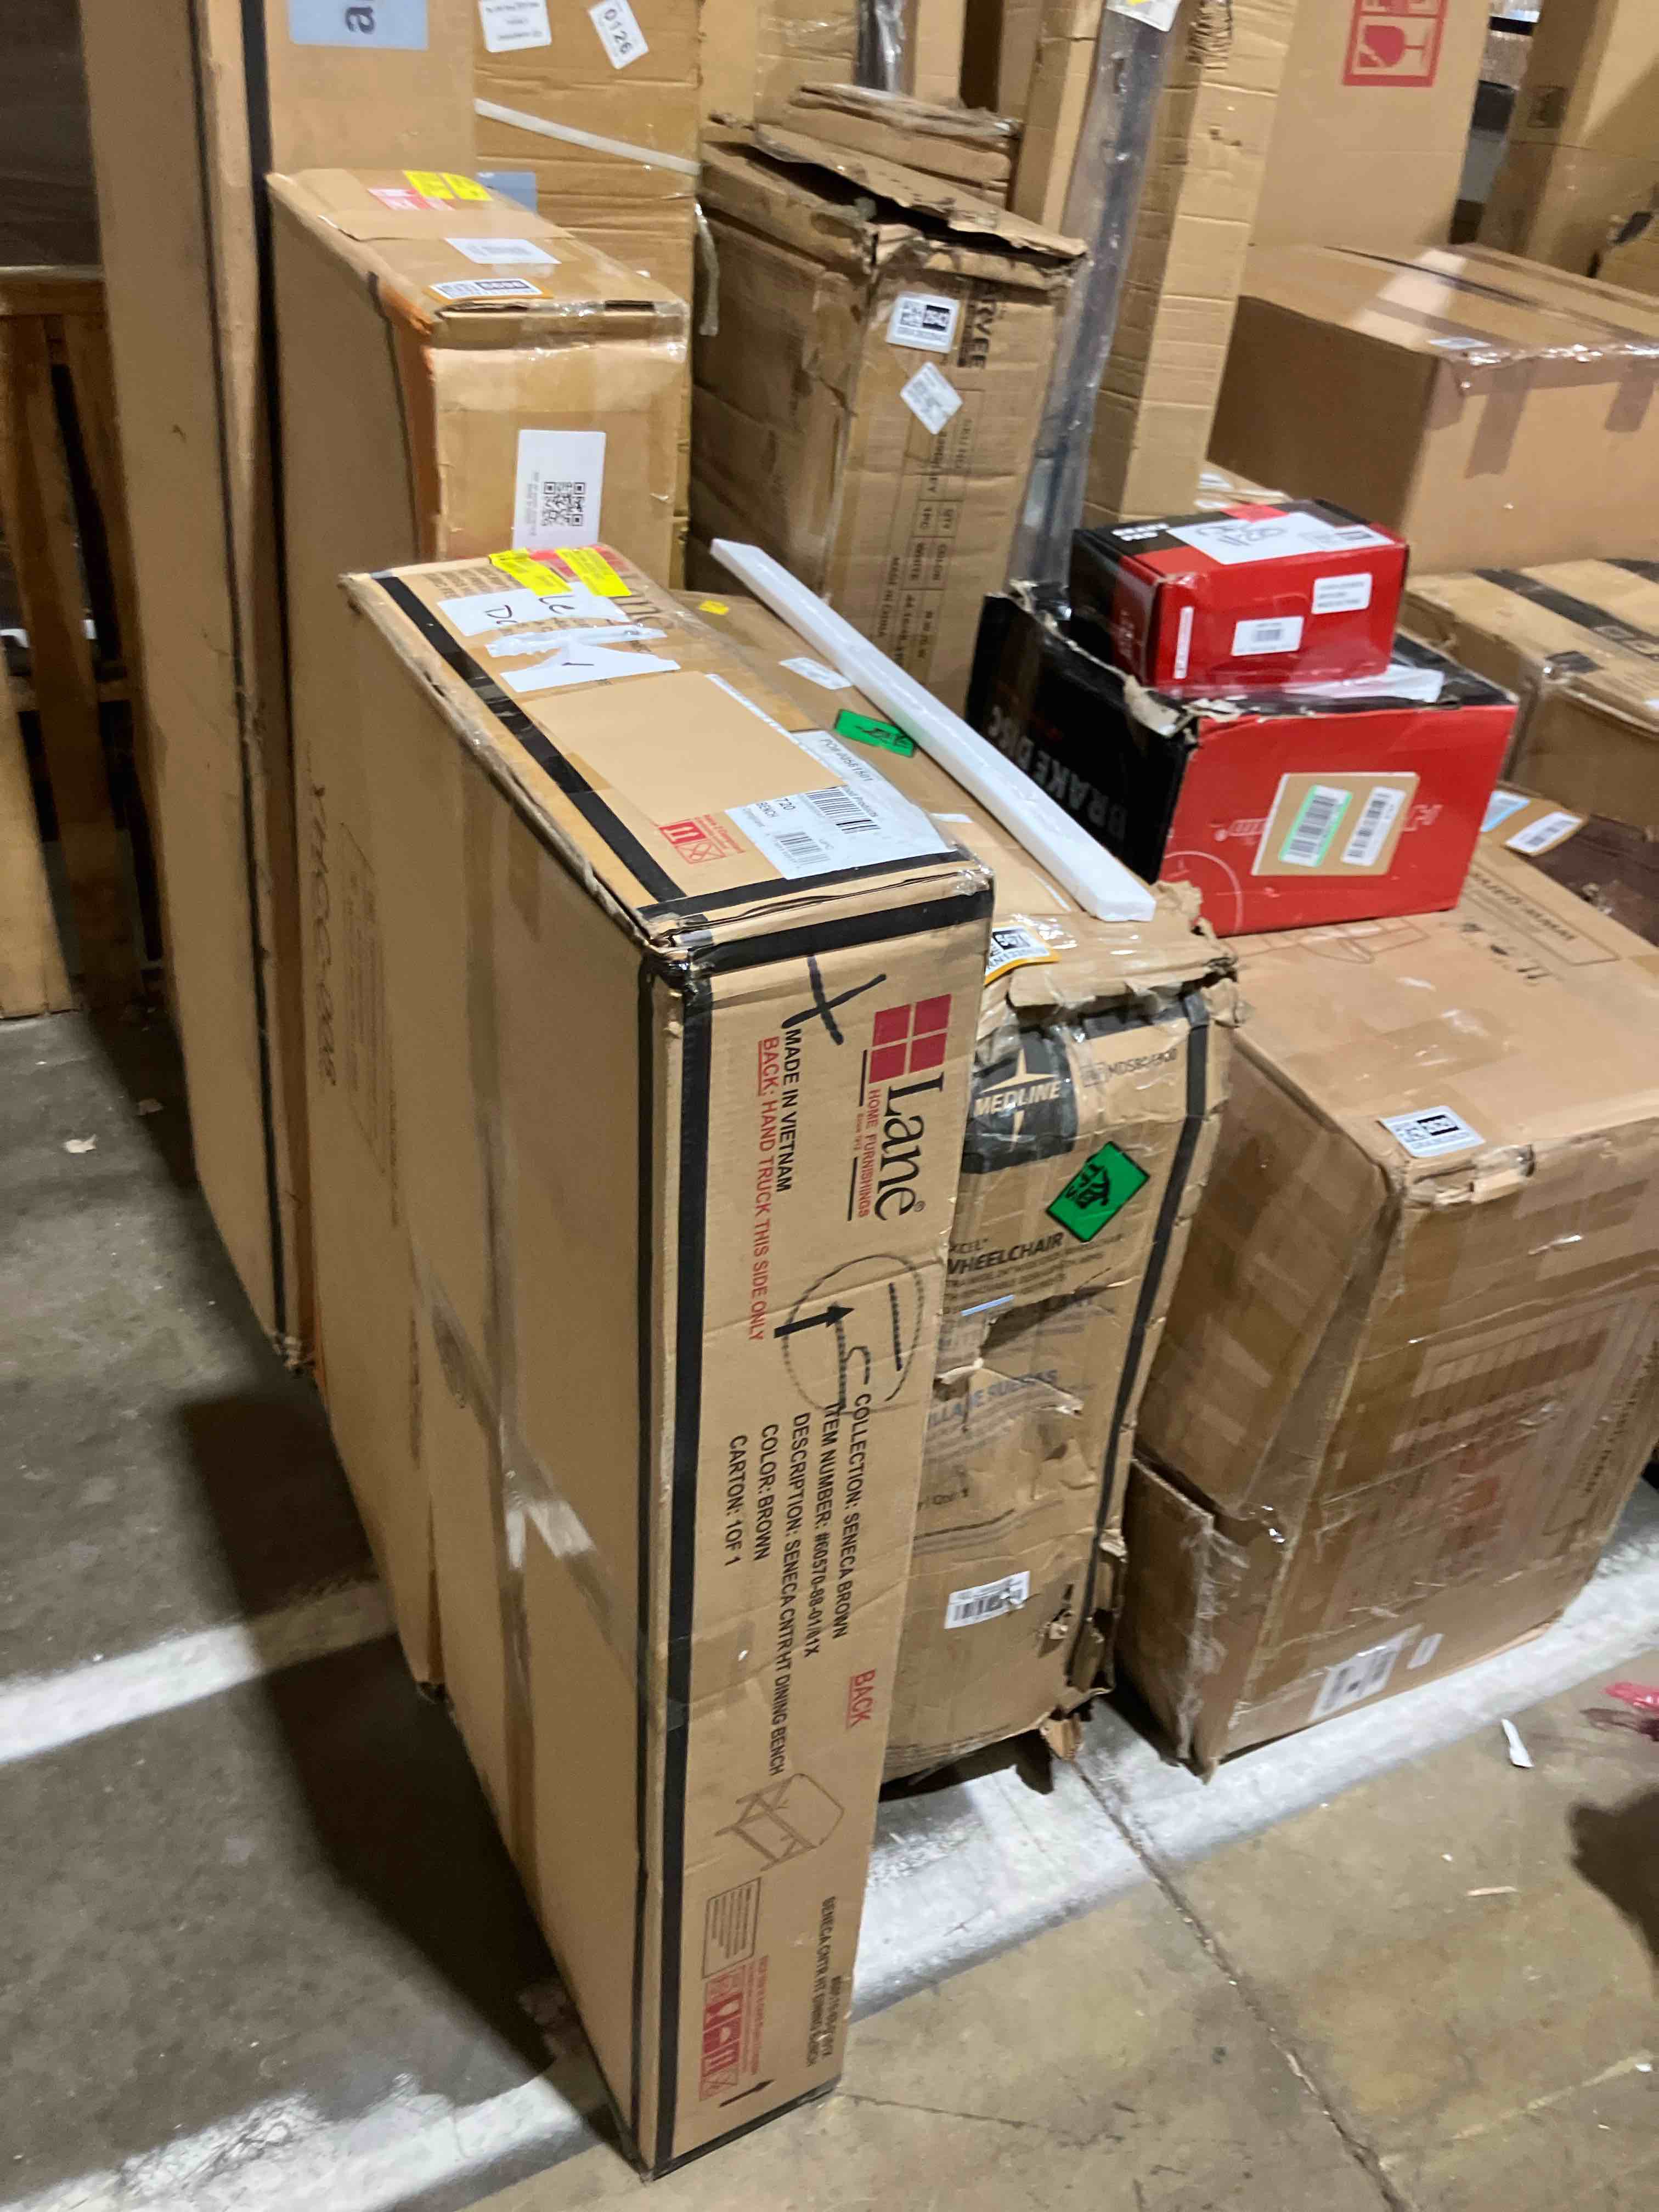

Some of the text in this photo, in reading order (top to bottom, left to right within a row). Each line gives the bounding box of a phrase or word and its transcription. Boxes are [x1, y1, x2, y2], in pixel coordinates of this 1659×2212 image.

[776, 1029, 802, 1193] MADE IN VIETNAM
[973, 1083, 1063, 1115] MEDLINE
[857, 1088, 882, 1218] HOME FURNISHINGS
[874, 1071, 945, 1221] Lane
[748, 1036, 780, 1341] BACK: HAND TRUCK THIS SIDE ONLY
[947, 1232, 1064, 1274] WHEELCHAIR
[821, 1402, 841, 1447] ITEM
[725, 1435, 748, 1516] CARTON:
[753, 1424, 780, 1561] COLOR: BROWN
[814, 1449, 837, 1528] NUMBER:
[832, 1393, 872, 1640] COLLECTION: SENECA BROWN
[768, 1412, 811, 1777] DESCRIPTION: SENECA CNTR HT DINING BENCH
[848, 1668, 877, 1729] BACK
[816, 1945, 831, 1976] CNTR
[818, 1896, 836, 1944] SENECA
